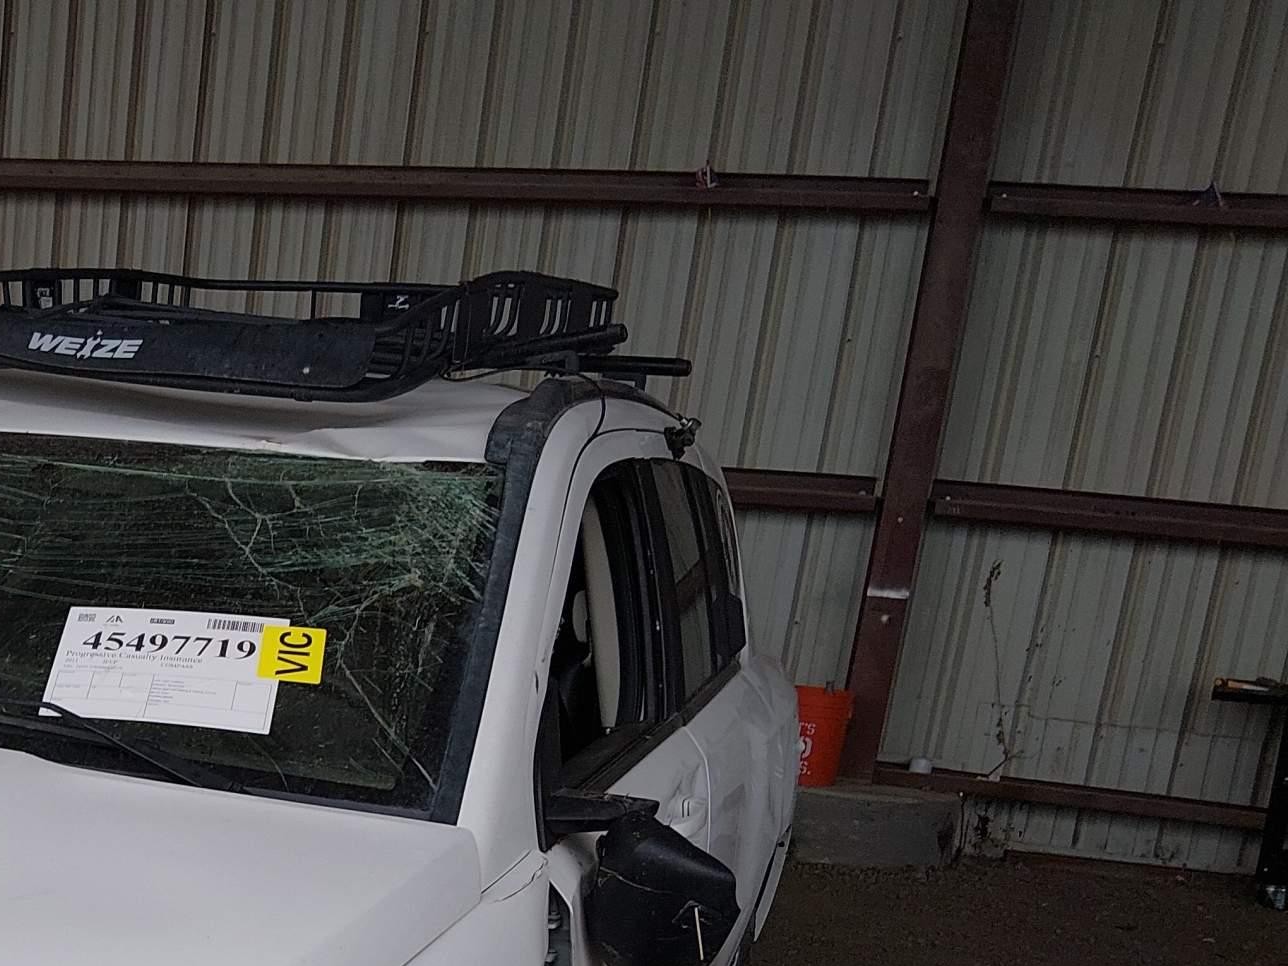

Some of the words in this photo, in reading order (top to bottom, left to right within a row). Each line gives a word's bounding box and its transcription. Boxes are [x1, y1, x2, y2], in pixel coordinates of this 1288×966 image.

[65, 650, 116, 660] Progressive
[119, 651, 157, 662] Casualty
[160, 654, 203, 664] Insurance
[83, 630, 258, 660] 45497719
[275, 630, 313, 676] VIC
